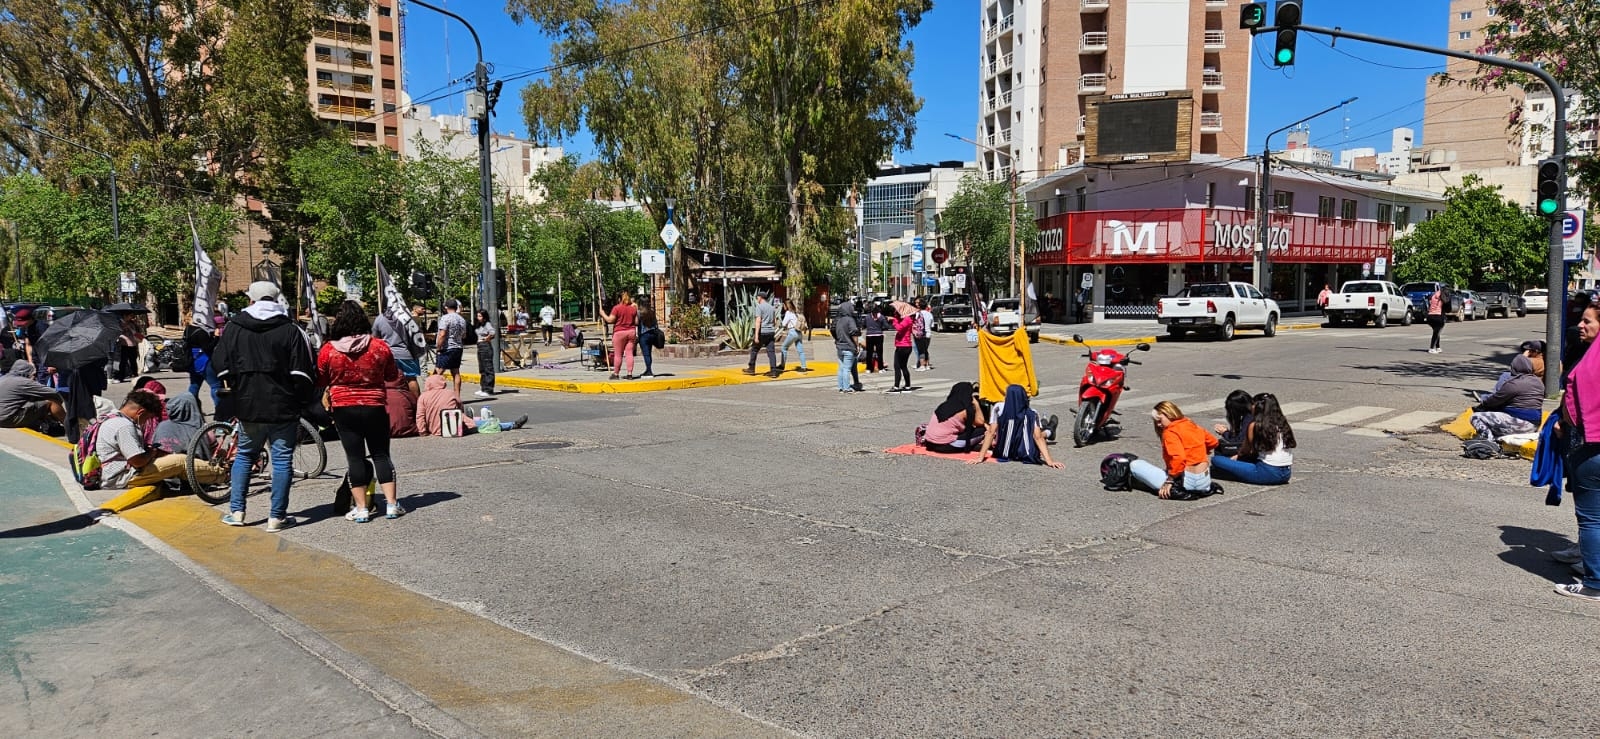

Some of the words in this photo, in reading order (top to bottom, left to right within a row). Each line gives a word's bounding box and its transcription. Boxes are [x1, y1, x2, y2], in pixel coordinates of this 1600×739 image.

[1253, 8, 1261, 22] 3
[1110, 219, 1159, 255] M
[1215, 220, 1290, 250] MOSZA
[1562, 218, 1573, 234] E
